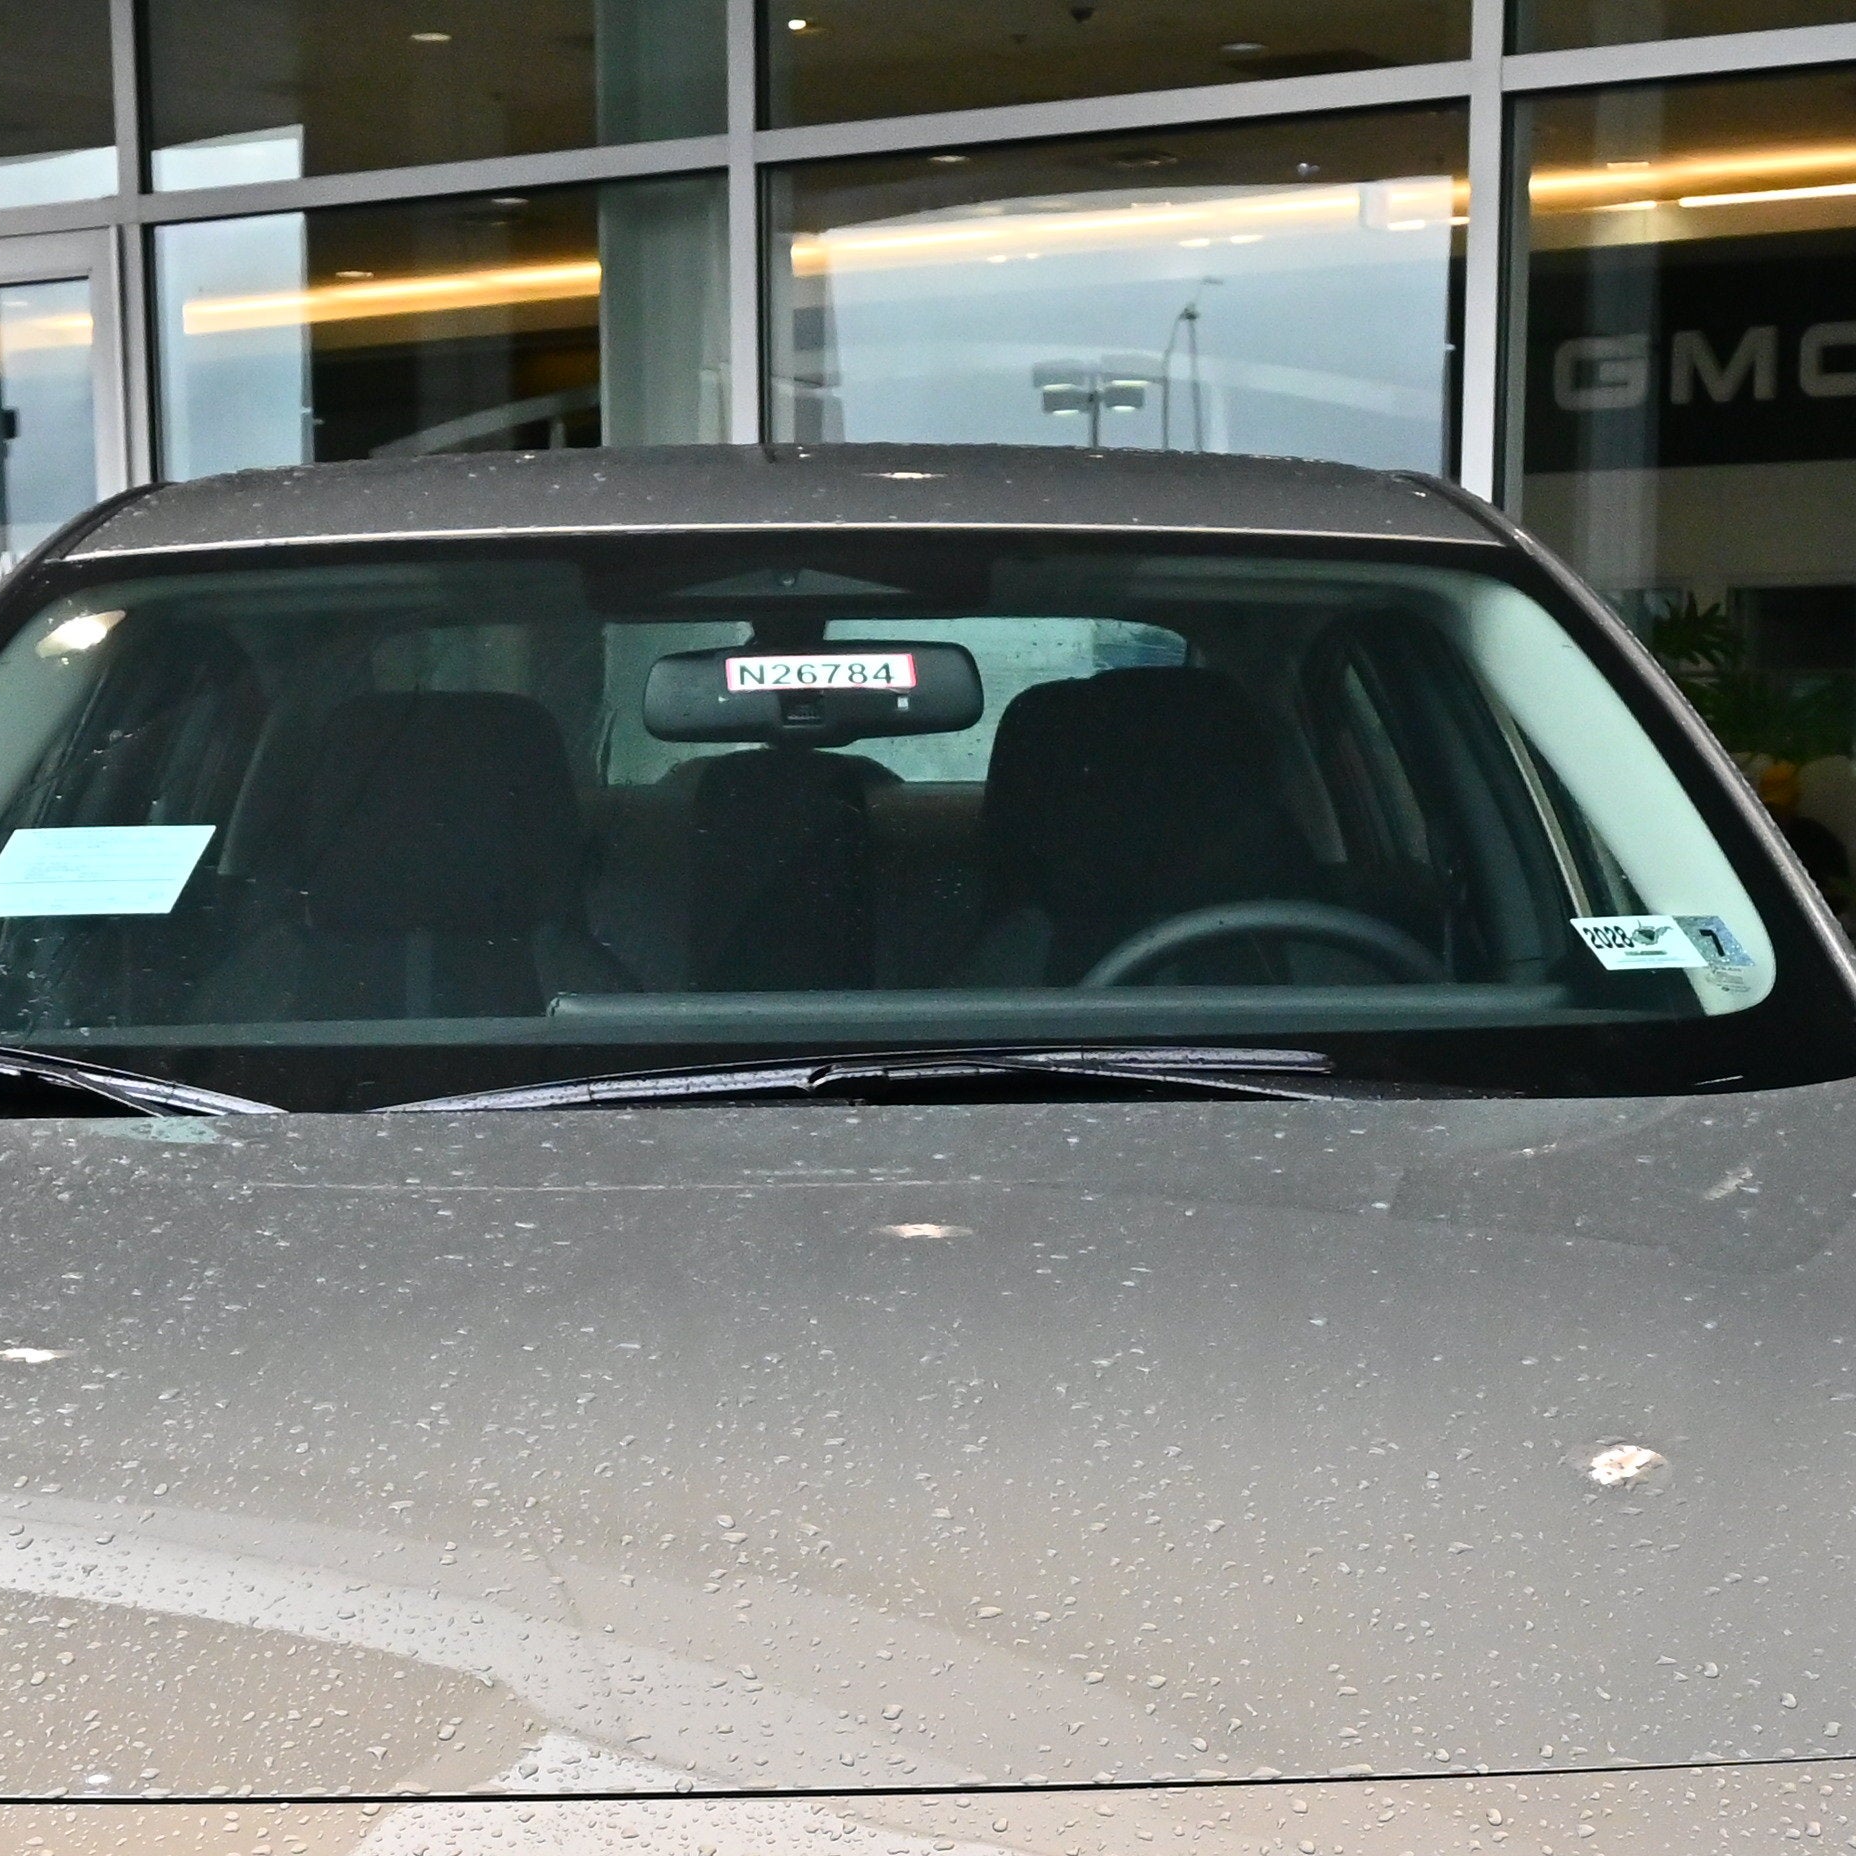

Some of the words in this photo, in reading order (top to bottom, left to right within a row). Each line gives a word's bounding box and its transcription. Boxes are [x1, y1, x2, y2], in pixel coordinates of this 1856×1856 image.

[738, 662, 895, 686] N26784
[1583, 925, 1635, 949] 2028
[1699, 929, 1725, 957] 7
